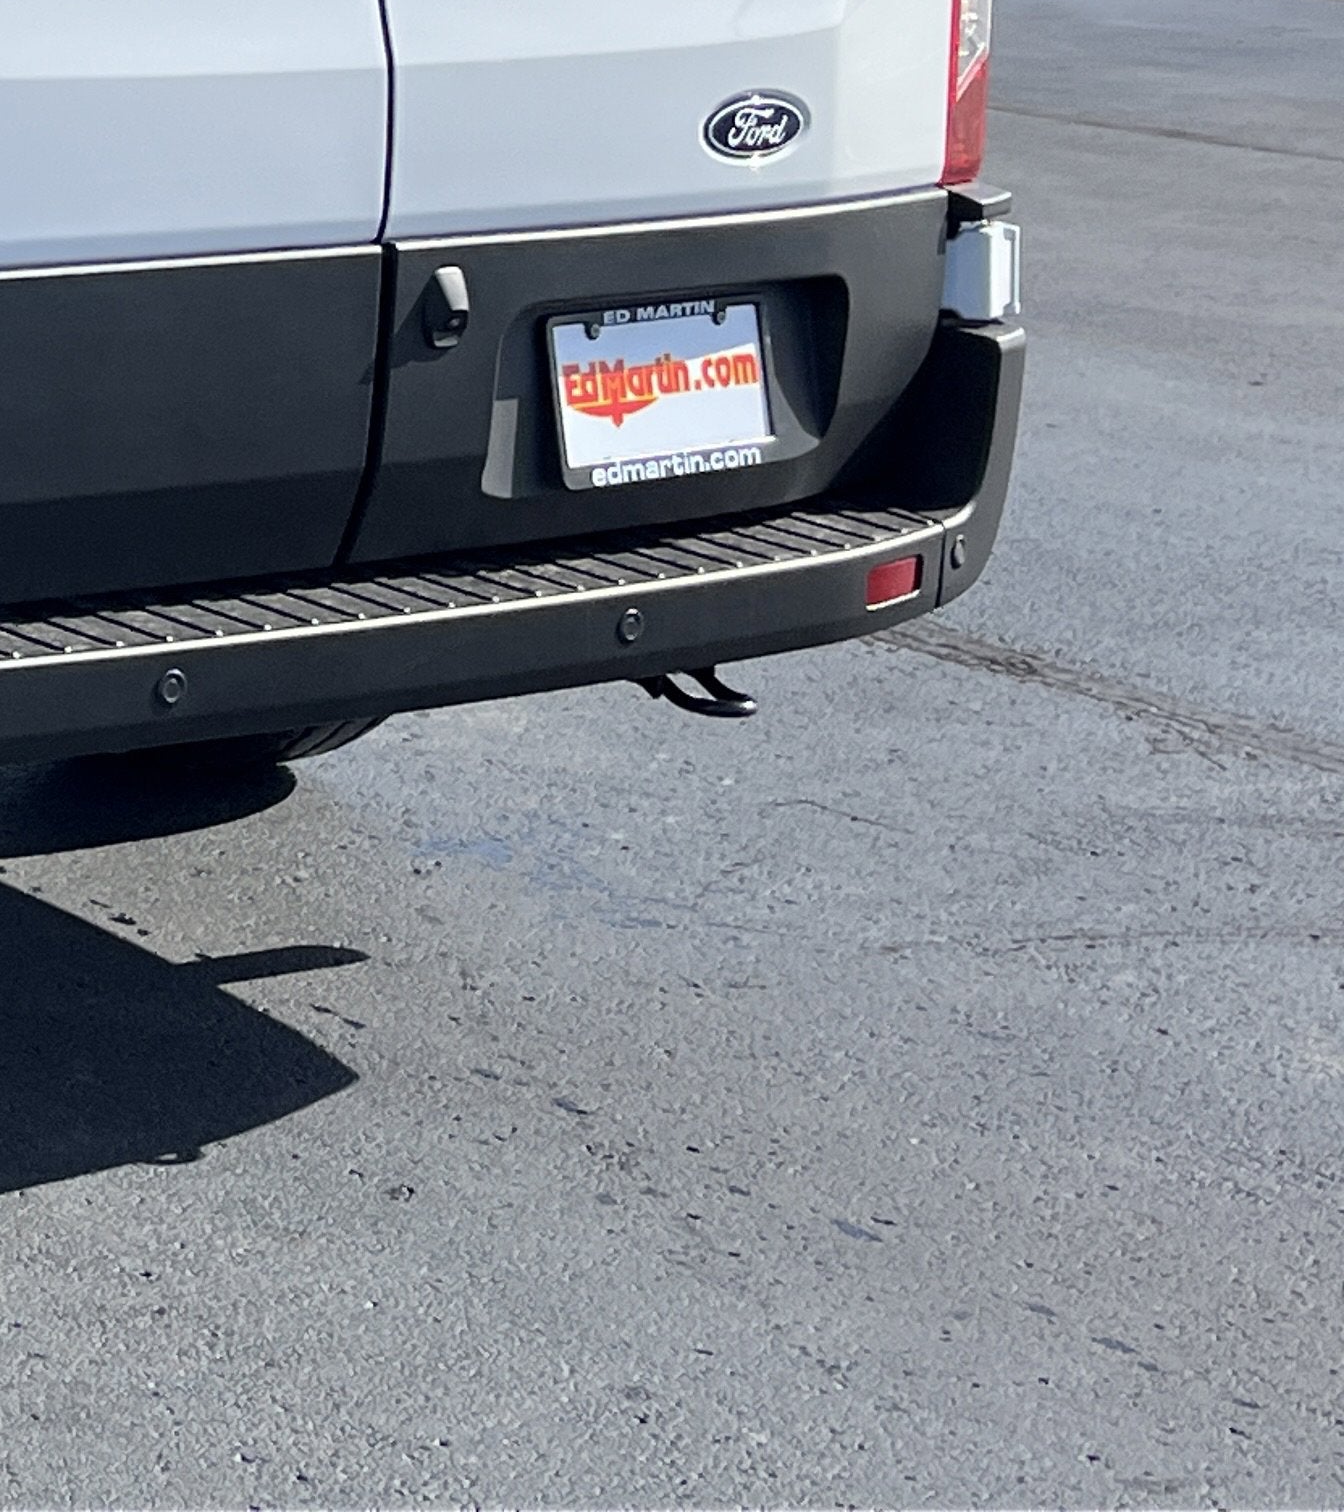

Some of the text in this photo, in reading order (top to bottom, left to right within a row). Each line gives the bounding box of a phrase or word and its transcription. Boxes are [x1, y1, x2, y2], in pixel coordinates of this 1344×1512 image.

[727, 107, 789, 148] Ford
[602, 300, 715, 325] ED MARTIN
[590, 446, 762, 487] edmartin.com
